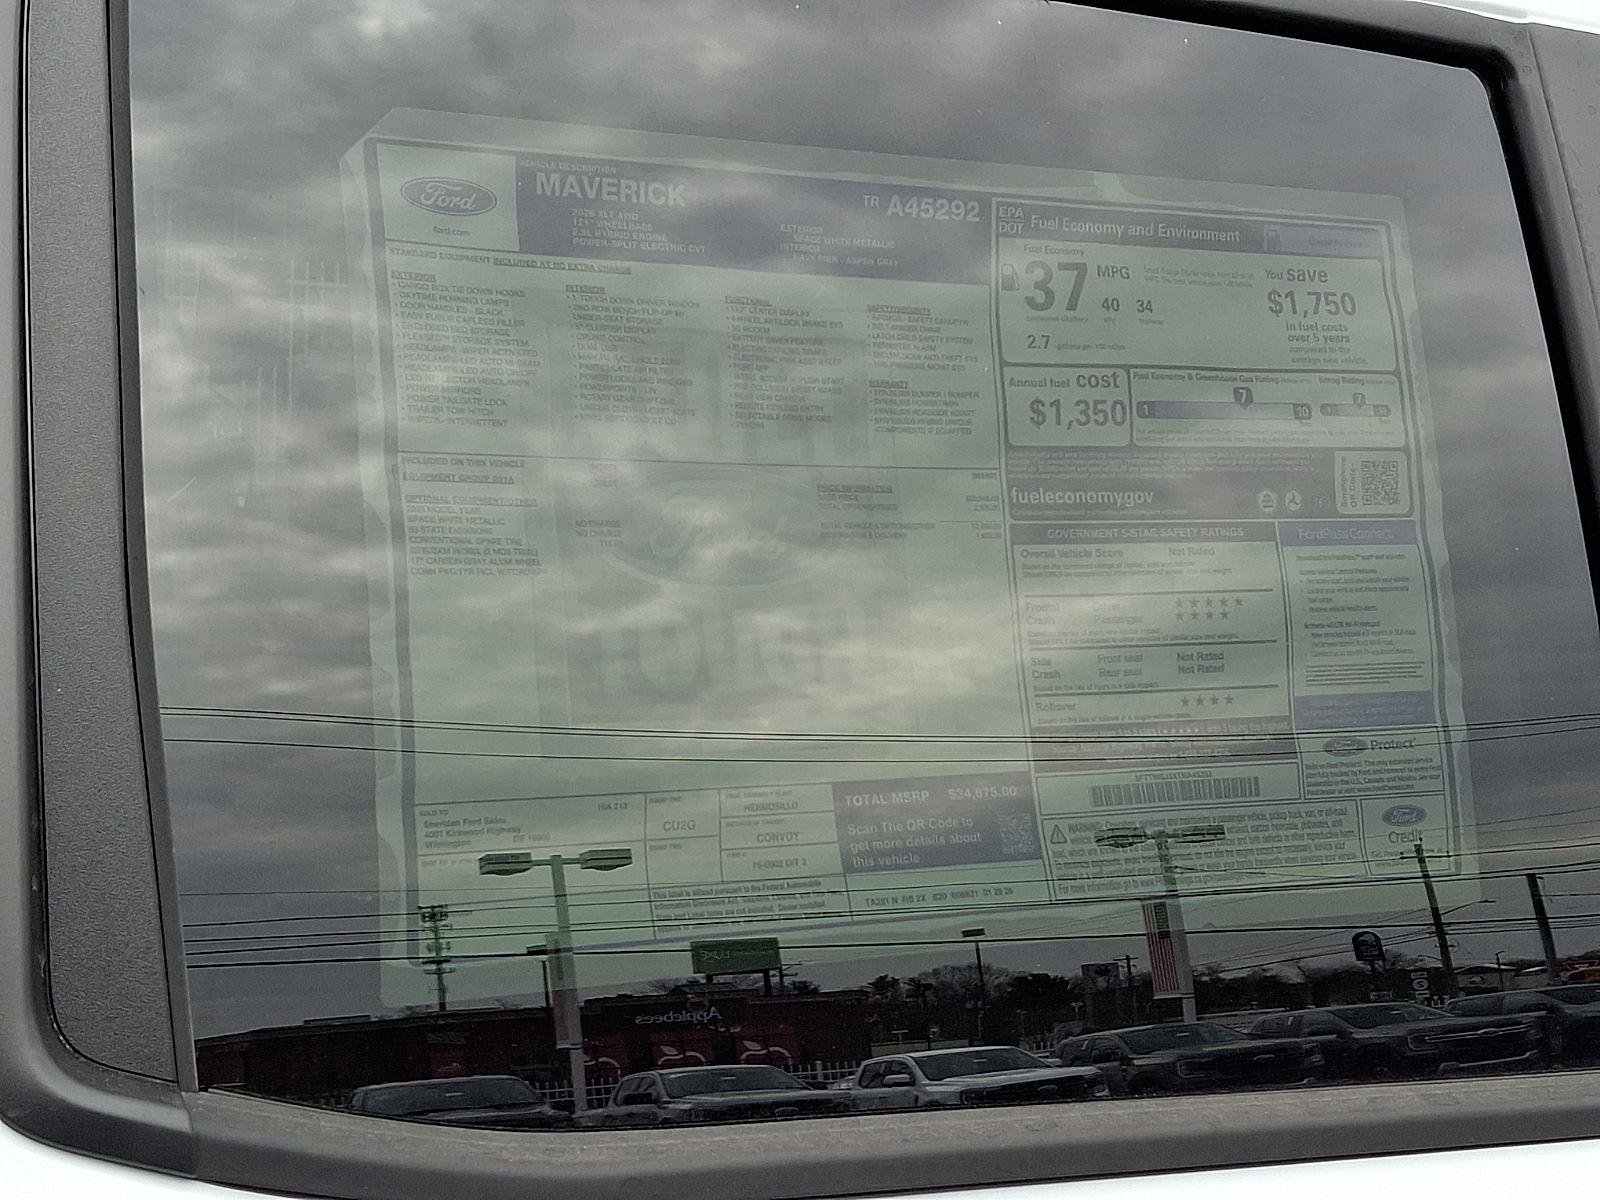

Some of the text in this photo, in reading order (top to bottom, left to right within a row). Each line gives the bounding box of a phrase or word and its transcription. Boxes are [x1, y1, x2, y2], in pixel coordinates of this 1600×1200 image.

[420, 181, 478, 210] Ford
[535, 171, 687, 208] MAVERICK
[862, 194, 981, 223] TR A45292
[999, 205, 1025, 220] EPA
[999, 221, 1024, 235] DOT
[1030, 214, 1242, 242] Fuel Economy and Environment
[1023, 243, 1086, 257] Fuel Economy
[1265, 268, 1284, 280] You
[1285, 267, 1329, 284] save
[1023, 259, 1089, 312] 37
[1096, 263, 1131, 281] MPG
[1100, 297, 1154, 314] 40 34
[1265, 287, 1358, 319] $1,750
[1285, 320, 1349, 332] in fuel costs
[1026, 333, 1052, 350] 2.7
[1287, 333, 1351, 345] over 5 years
[1007, 371, 1122, 390] Annual fuel cost
[1239, 389, 1248, 404] 7
[1028, 397, 1129, 430] $1,350
[1047, 528, 1119, 539] GOVERNMENT
[1159, 528, 1199, 538] SAFETY
[1200, 527, 1245, 538] RATINGS
[1168, 546, 1186, 557] Not
[1187, 546, 1217, 557] Rated
[1097, 653, 1123, 664] Front
[1177, 652, 1195, 662] Not
[1196, 651, 1225, 662] Rated
[1031, 668, 1062, 680] Crash
[1098, 666, 1122, 678] Rear
[1178, 664, 1196, 675] Not
[1197, 663, 1226, 674] Rated
[1035, 701, 1078, 712] Rollover
[1369, 738, 1415, 751] Protect
[845, 793, 888, 808] TOTAL
[890, 790, 931, 805] MSRP
[662, 820, 697, 833] CU2G
[848, 816, 974, 836] Scan The QR Code to
[756, 830, 801, 844] CONVOY
[849, 831, 982, 855] get more details about
[852, 852, 921, 868] this vehicle
